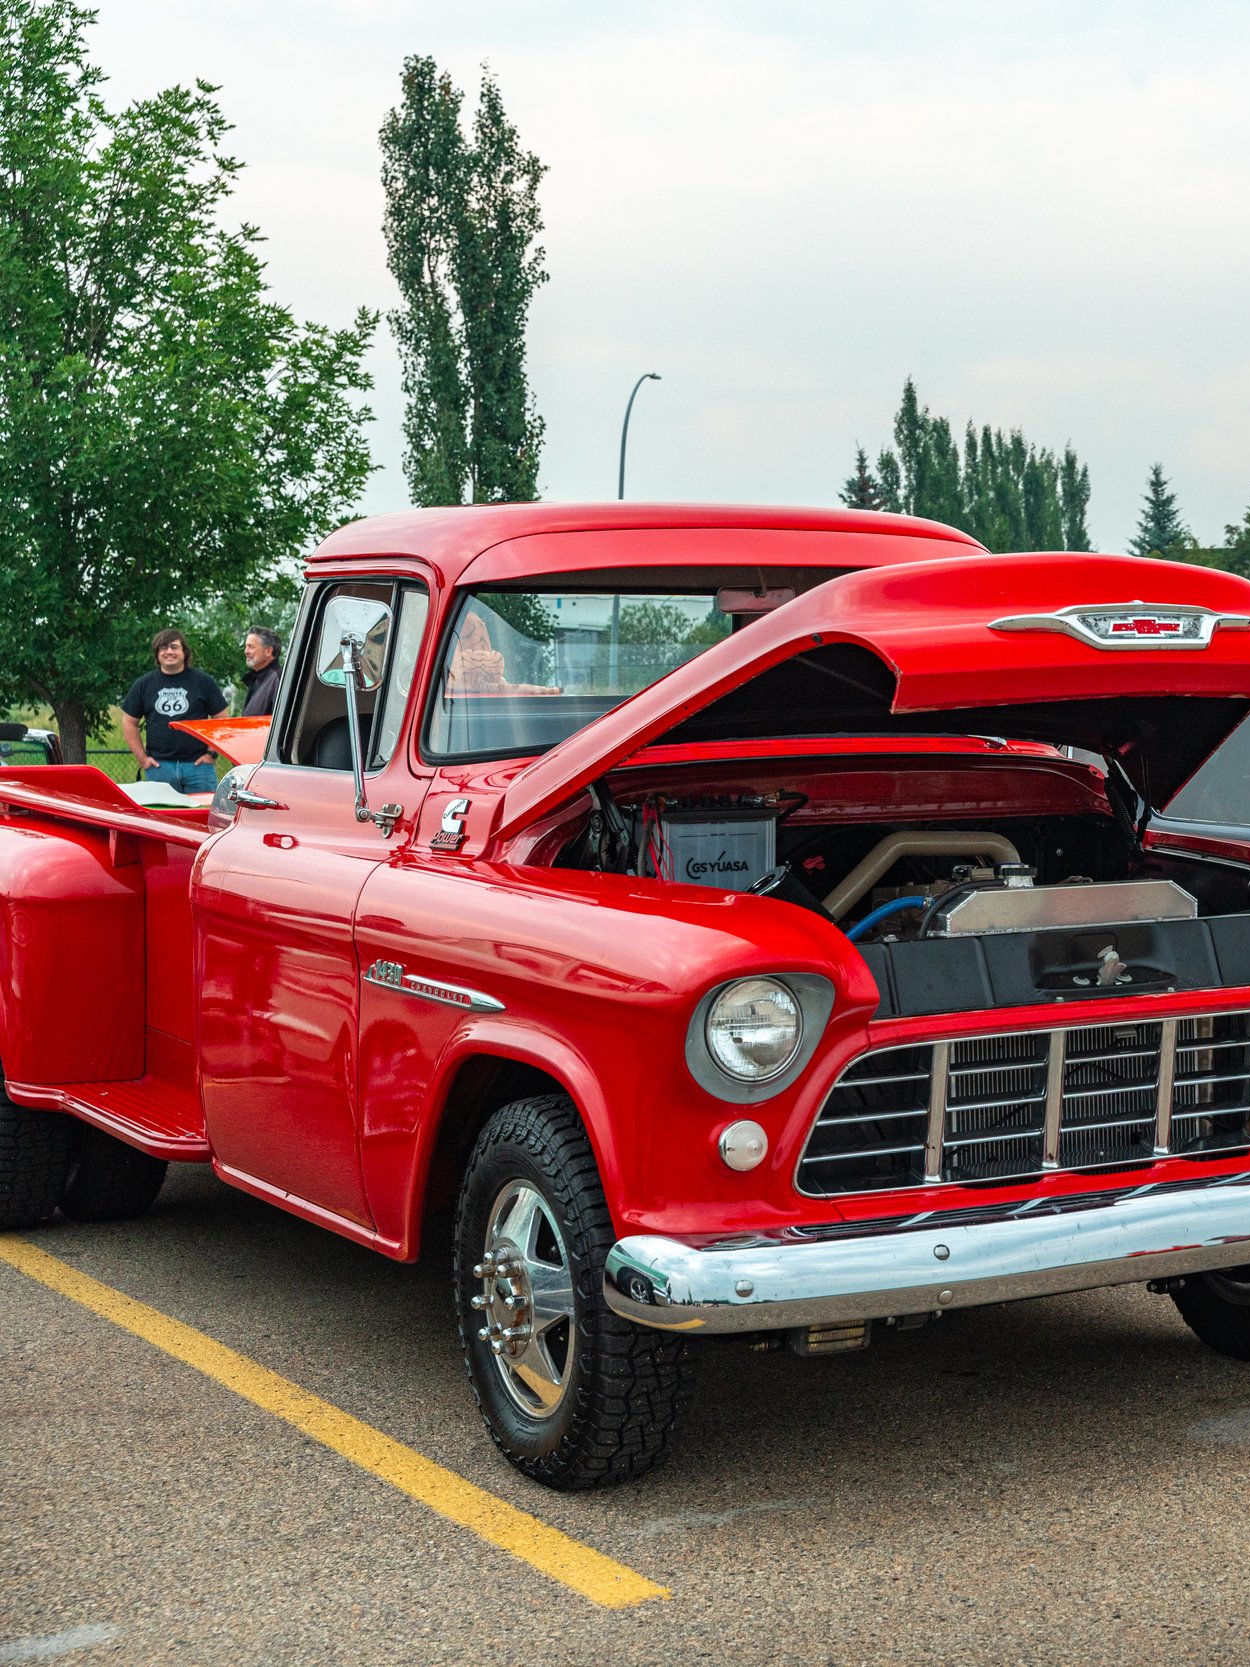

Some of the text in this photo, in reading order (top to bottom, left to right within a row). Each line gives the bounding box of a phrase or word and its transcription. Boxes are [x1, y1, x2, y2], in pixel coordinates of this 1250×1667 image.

[162, 700, 182, 712] 66
[431, 831, 465, 846] Power
[709, 855, 749, 873] YUASA
[410, 981, 465, 1002] CHEVROLET
